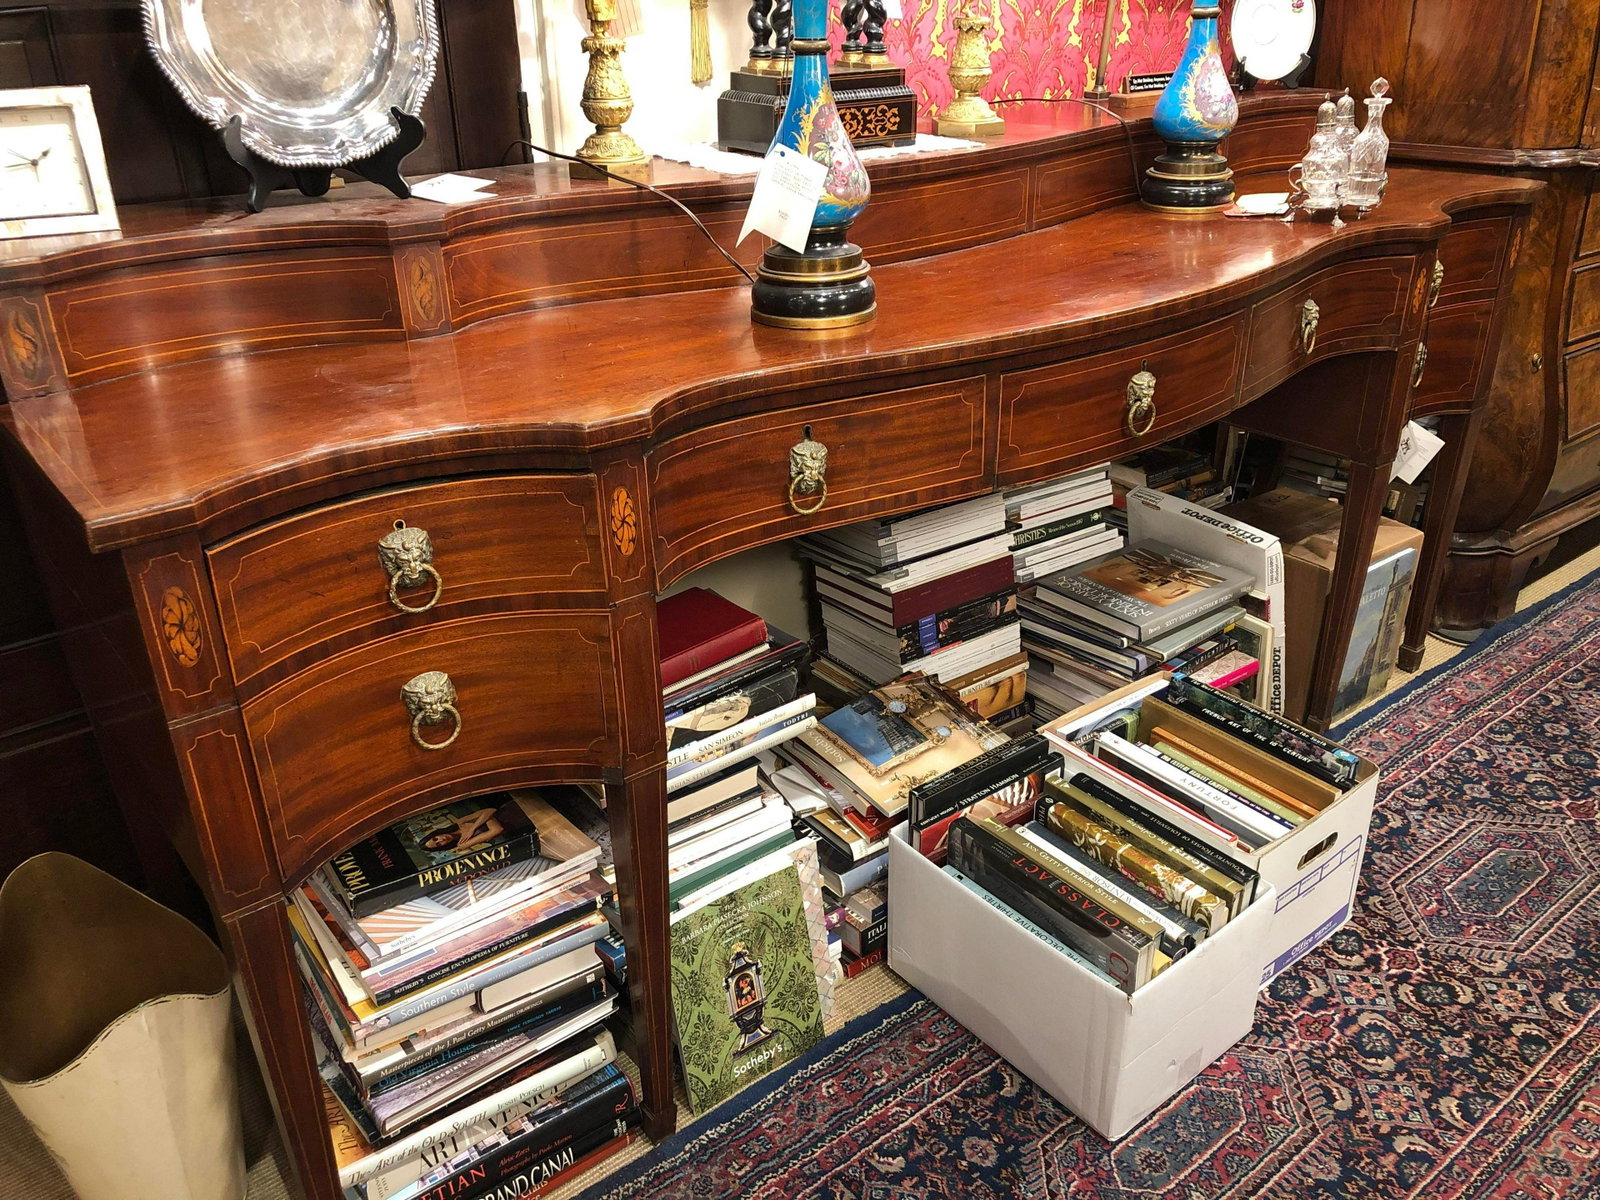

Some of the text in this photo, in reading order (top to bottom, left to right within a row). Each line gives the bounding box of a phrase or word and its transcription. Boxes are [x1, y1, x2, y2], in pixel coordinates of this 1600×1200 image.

[782, 711, 809, 728] TODTRI
[1201, 707, 1227, 723] FRENCH
[1227, 719, 1242, 730] ART
[1241, 726, 1253, 736] OF
[1253, 732, 1267, 742] THE
[1282, 746, 1313, 765] CENTURY
[698, 740, 715, 753] SAN
[714, 728, 745, 747] SIMEON
[1310, 736, 1327, 748] South
[959, 787, 991, 807] STRATTON
[990, 772, 1020, 791] HAMMON
[1178, 774, 1238, 813] FORTUNY
[1126, 816, 1210, 876] Hearst the Collector
[1149, 813, 1182, 839] LOUISVILLE
[417, 843, 512, 888] PROVENANCE
[1022, 838, 1119, 907] ANN GETTY INTERIOR STYLE
[1011, 851, 1122, 935] CLASS ACT
[1091, 871, 1134, 907] WINDSOR
[681, 923, 713, 944] BARBARA
[713, 905, 747, 926] PIASECKA
[746, 887, 783, 910] JOHNSON
[982, 891, 1082, 967] THE DECORATIVE THIRTIES
[1290, 921, 1335, 956] Office DEPOT
[393, 931, 530, 996] SOTHEBY'S CONCISE ENCYCLOPEDIA OF FURNITURE
[399, 993, 448, 1020] Southern
[449, 982, 476, 1000] Style
[379, 1053, 425, 1079] Masterpieces
[424, 1048, 434, 1058] of
[434, 1043, 446, 1055] the
[452, 1032, 468, 1045] Paul
[466, 1025, 486, 1039] Getty
[485, 1011, 517, 1030] Museum:
[515, 999, 544, 1016] DRAWINGS
[378, 1071, 400, 1088] Old
[439, 1041, 475, 1062] Houses
[732, 1043, 783, 1079] Sotheby's
[348, 1171, 366, 1186] The
[366, 1154, 397, 1176] ART
[397, 1149, 409, 1162] of
[408, 1144, 420, 1156] the
[420, 1130, 448, 1149] OLD
[449, 1110, 488, 1134] SOUTH
[518, 1083, 546, 1100] POESCH
[418, 1135, 461, 1175] ART
[530, 1147, 579, 1187] CANAL
